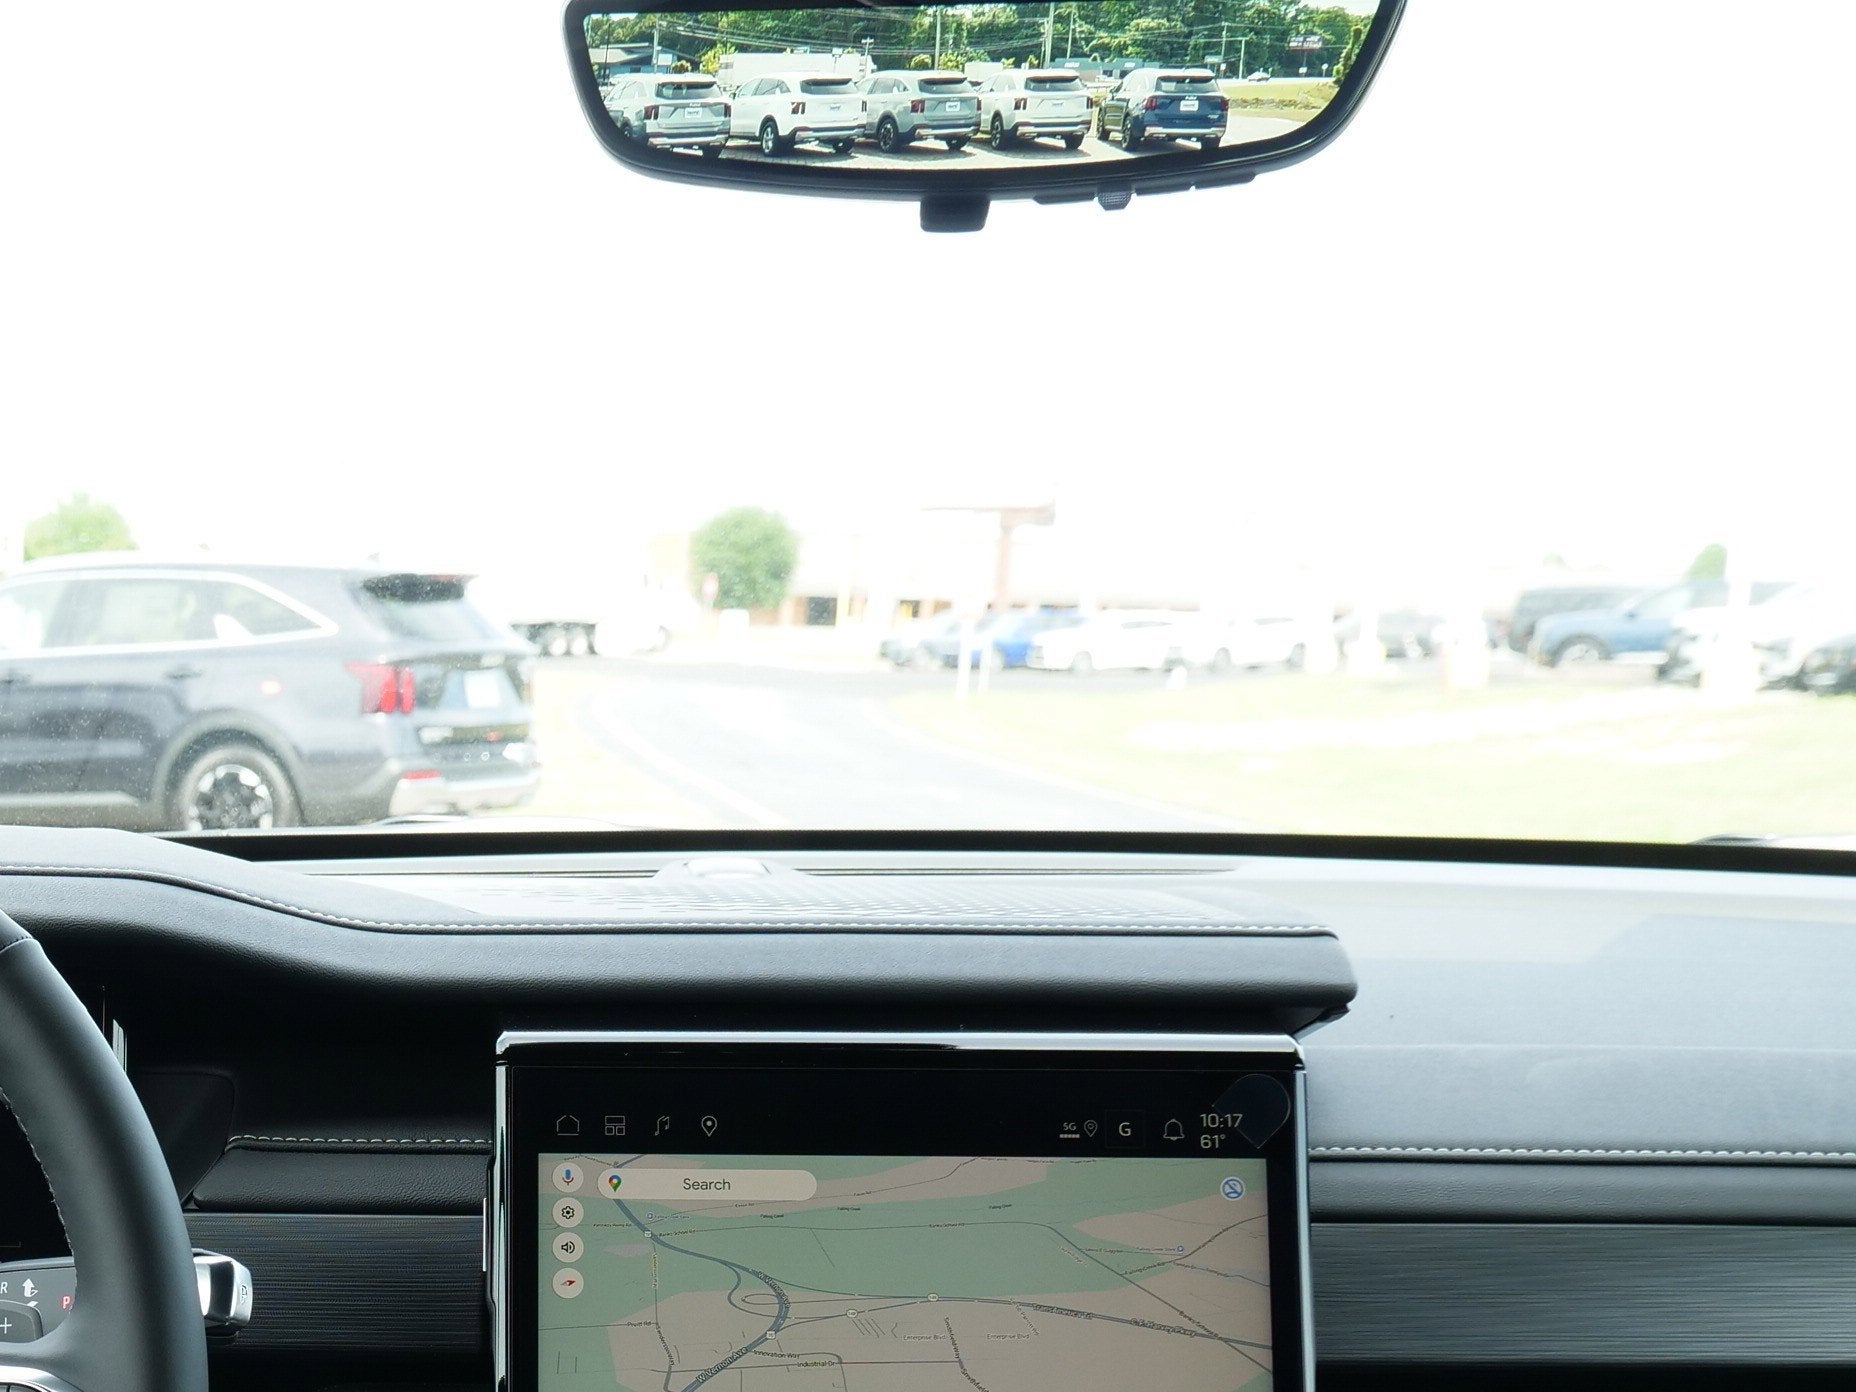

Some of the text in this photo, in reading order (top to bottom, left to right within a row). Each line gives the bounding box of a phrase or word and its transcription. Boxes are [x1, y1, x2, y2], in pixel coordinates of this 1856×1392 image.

[1062, 1122, 1077, 1131] 5G
[1200, 1113, 1243, 1128] 10:17
[1118, 1122, 1131, 1137] G
[1200, 1134, 1226, 1149] 61°
[682, 1178, 731, 1191] Search
[0, 1281, 8, 1294] R
[62, 1296, 71, 1310] P
[753, 1350, 785, 1358] Innovation
[705, 1356, 733, 1378] Vernon
[731, 1346, 748, 1362] Ave
